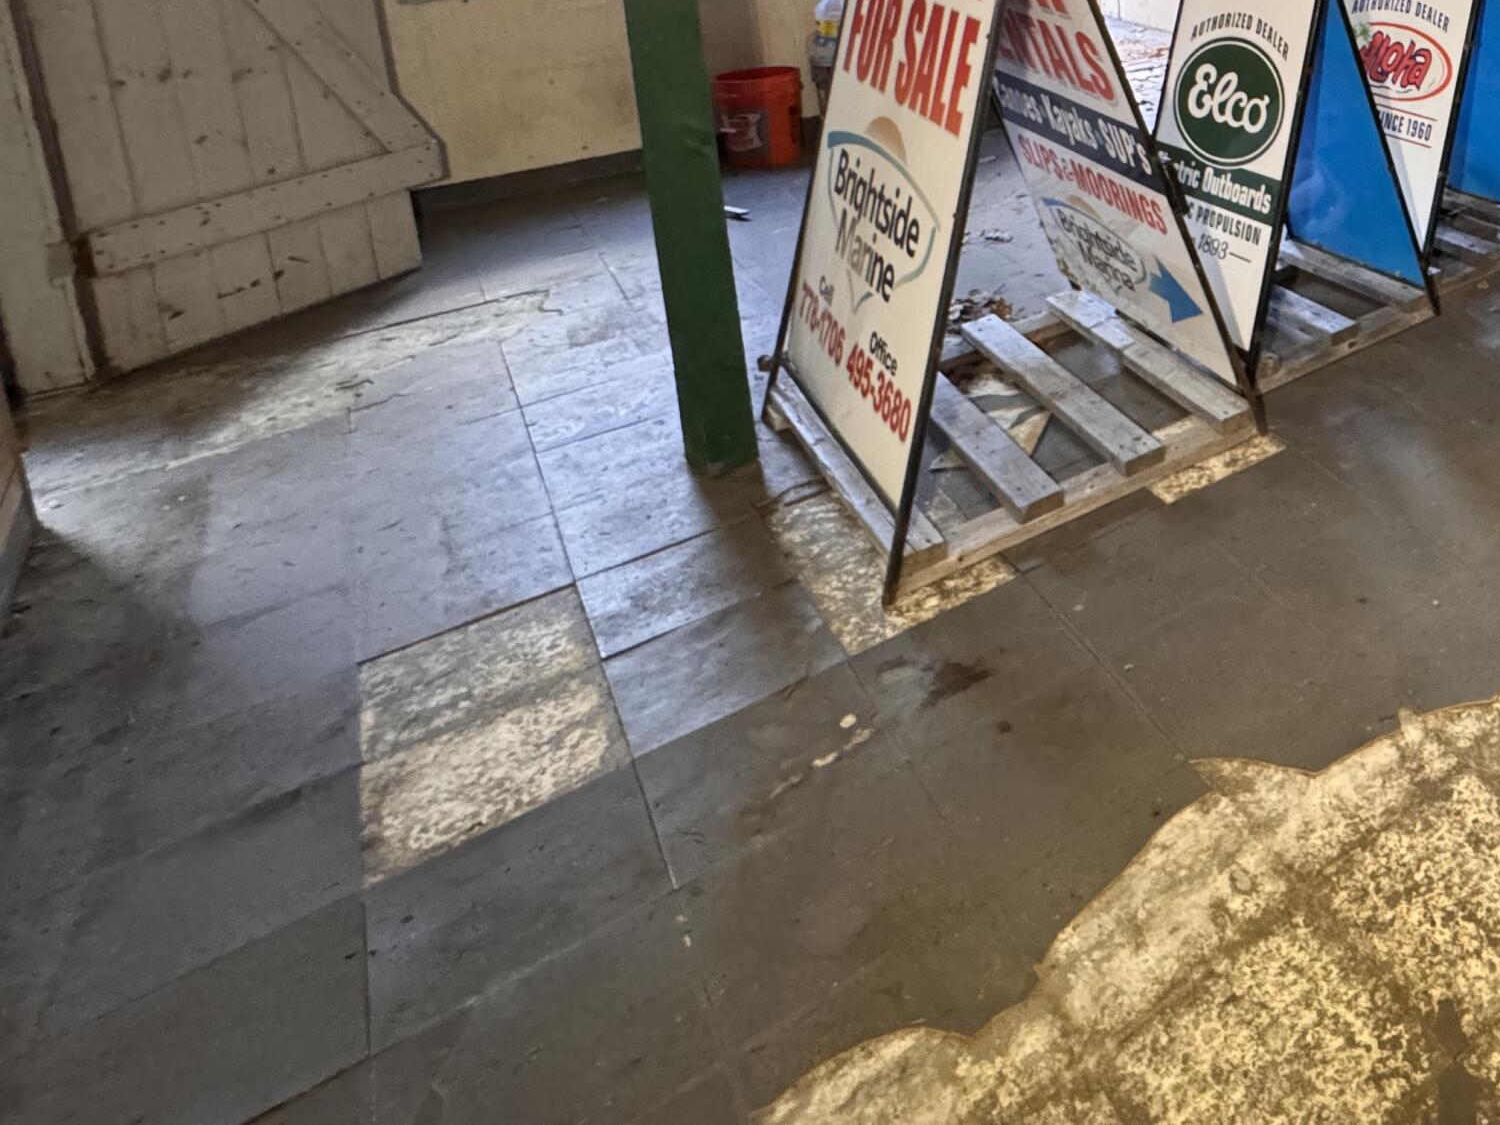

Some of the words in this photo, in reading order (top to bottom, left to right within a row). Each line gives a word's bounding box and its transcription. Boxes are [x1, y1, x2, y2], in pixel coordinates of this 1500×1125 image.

[1190, 12, 1254, 42] AUTHORIZED
[1256, 18, 1289, 61] DEALER
[1415, 1, 1450, 33] DEALER
[1040, 93, 1098, 150] Kayaks
[1187, 63, 1270, 134] Elco
[1379, 111, 1405, 133] INCE
[1406, 118, 1433, 142] 1960
[834, 148, 920, 258] Brightside
[1017, 133, 1064, 181] SLIPS
[1070, 159, 1168, 236] MOORINGS
[1201, 166, 1272, 214] Outboards
[1196, 205, 1262, 246] PROPULSION
[1197, 233, 1229, 260] 1893
[834, 208, 896, 303] Marine
[870, 331, 898, 377] Office
[846, 343, 912, 443] 495-3680
